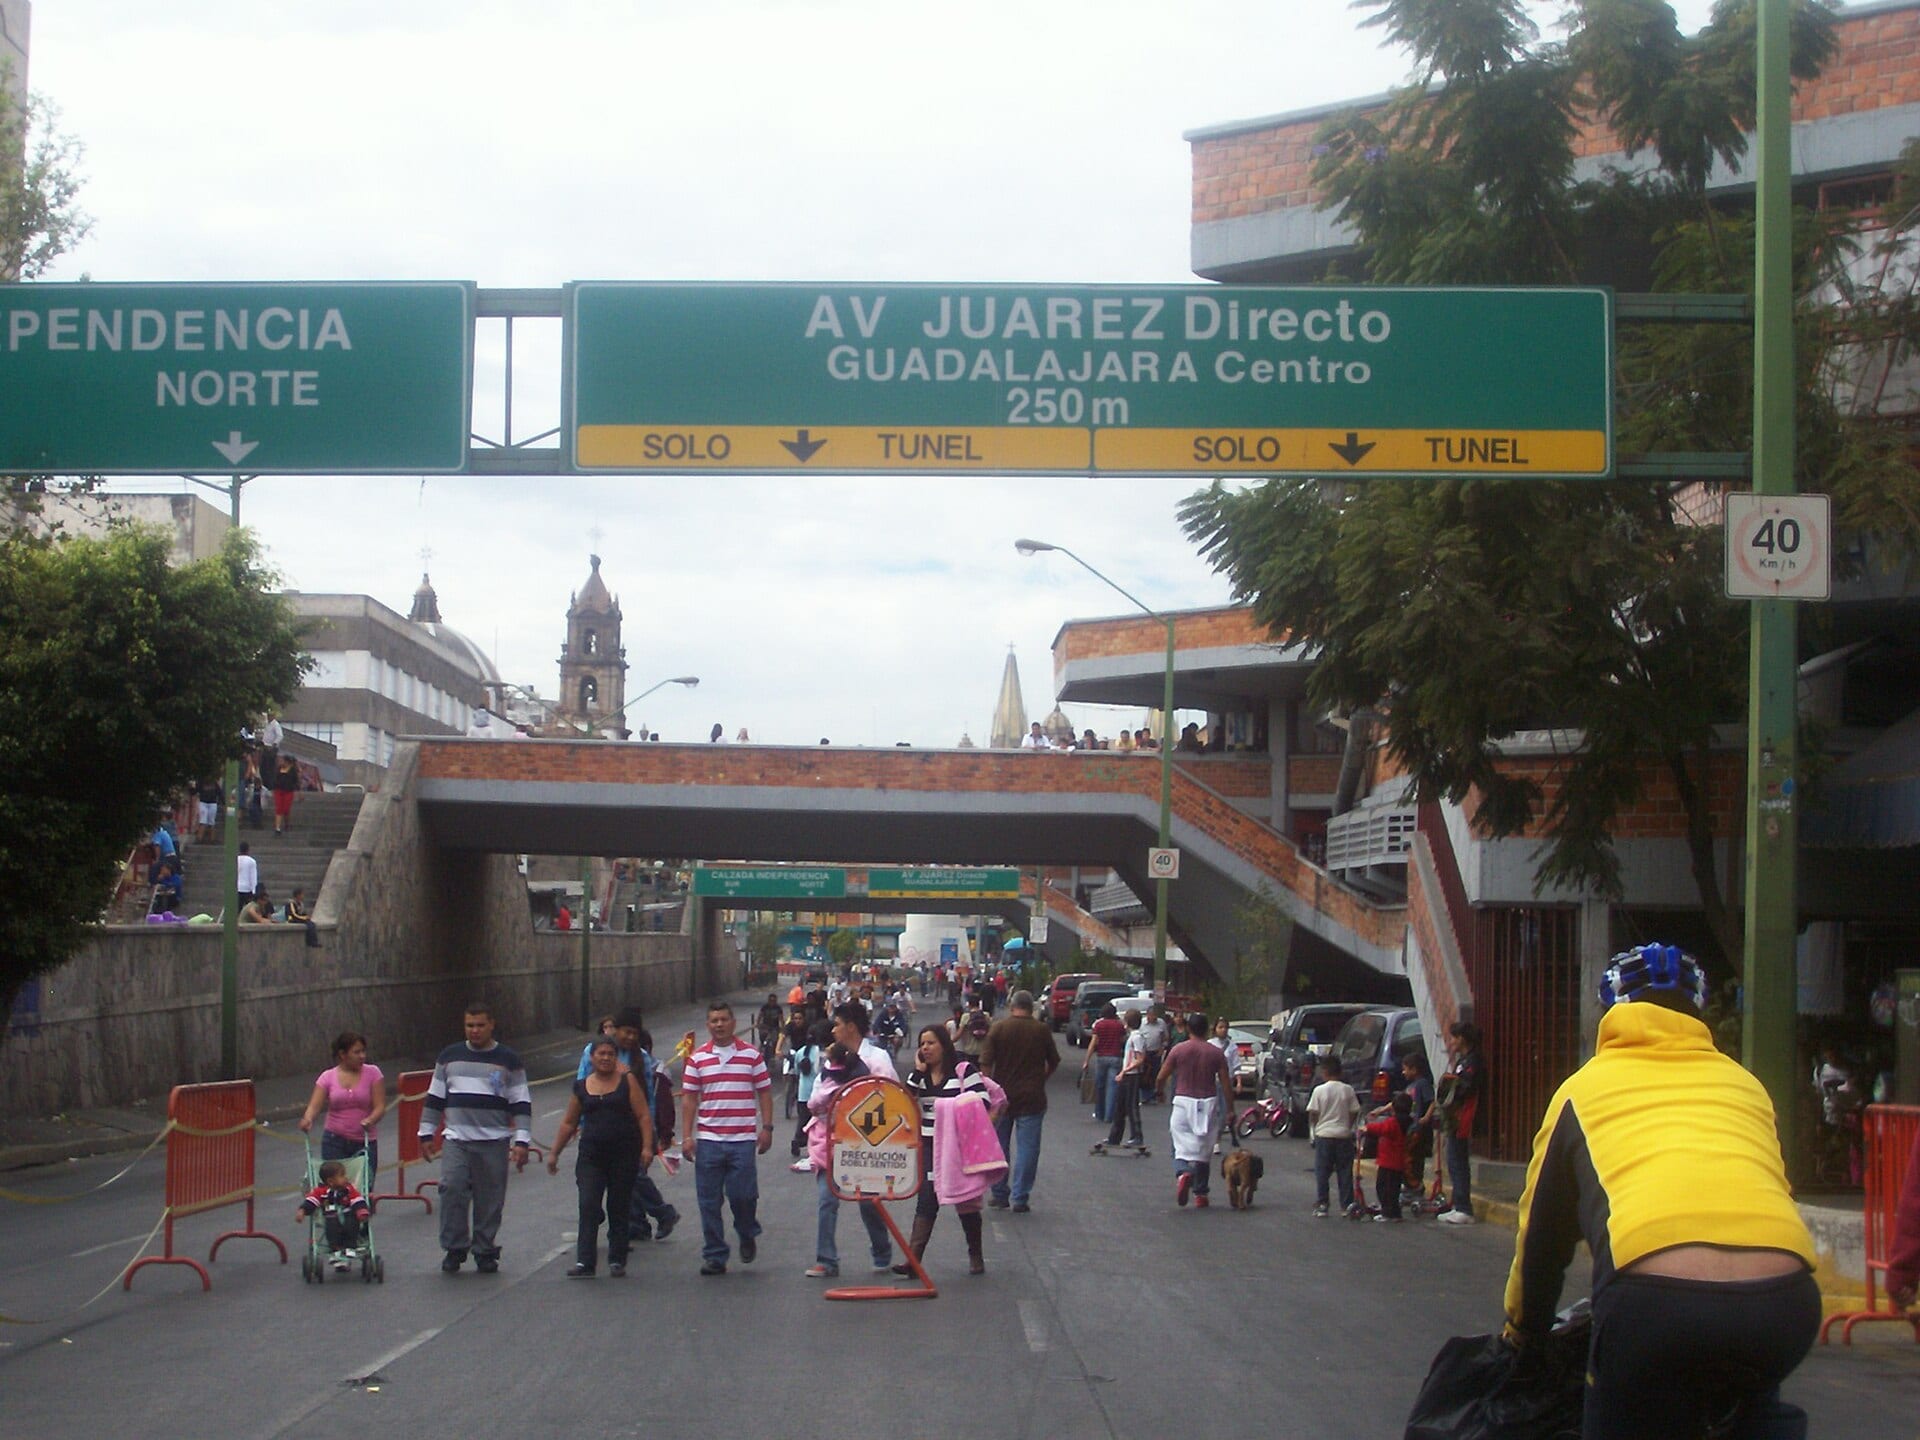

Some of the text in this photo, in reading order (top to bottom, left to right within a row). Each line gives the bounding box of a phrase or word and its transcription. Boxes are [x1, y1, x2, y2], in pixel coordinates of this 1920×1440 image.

[0, 307, 352, 351] PENDENCIA
[804, 295, 1392, 343] AV JUAREZ Directo
[826, 345, 1372, 385] GUADALAJARA Centro
[156, 370, 320, 406] NORTE
[643, 433, 983, 461] SOLO TUNEL
[1193, 436, 1530, 465] SOLO TUNEL
[1751, 518, 1801, 555] 40
[711, 871, 754, 880] CALZADA
[1155, 855, 1170, 865] 40
[840, 1160, 907, 1169] DOBLE SENTIDO
